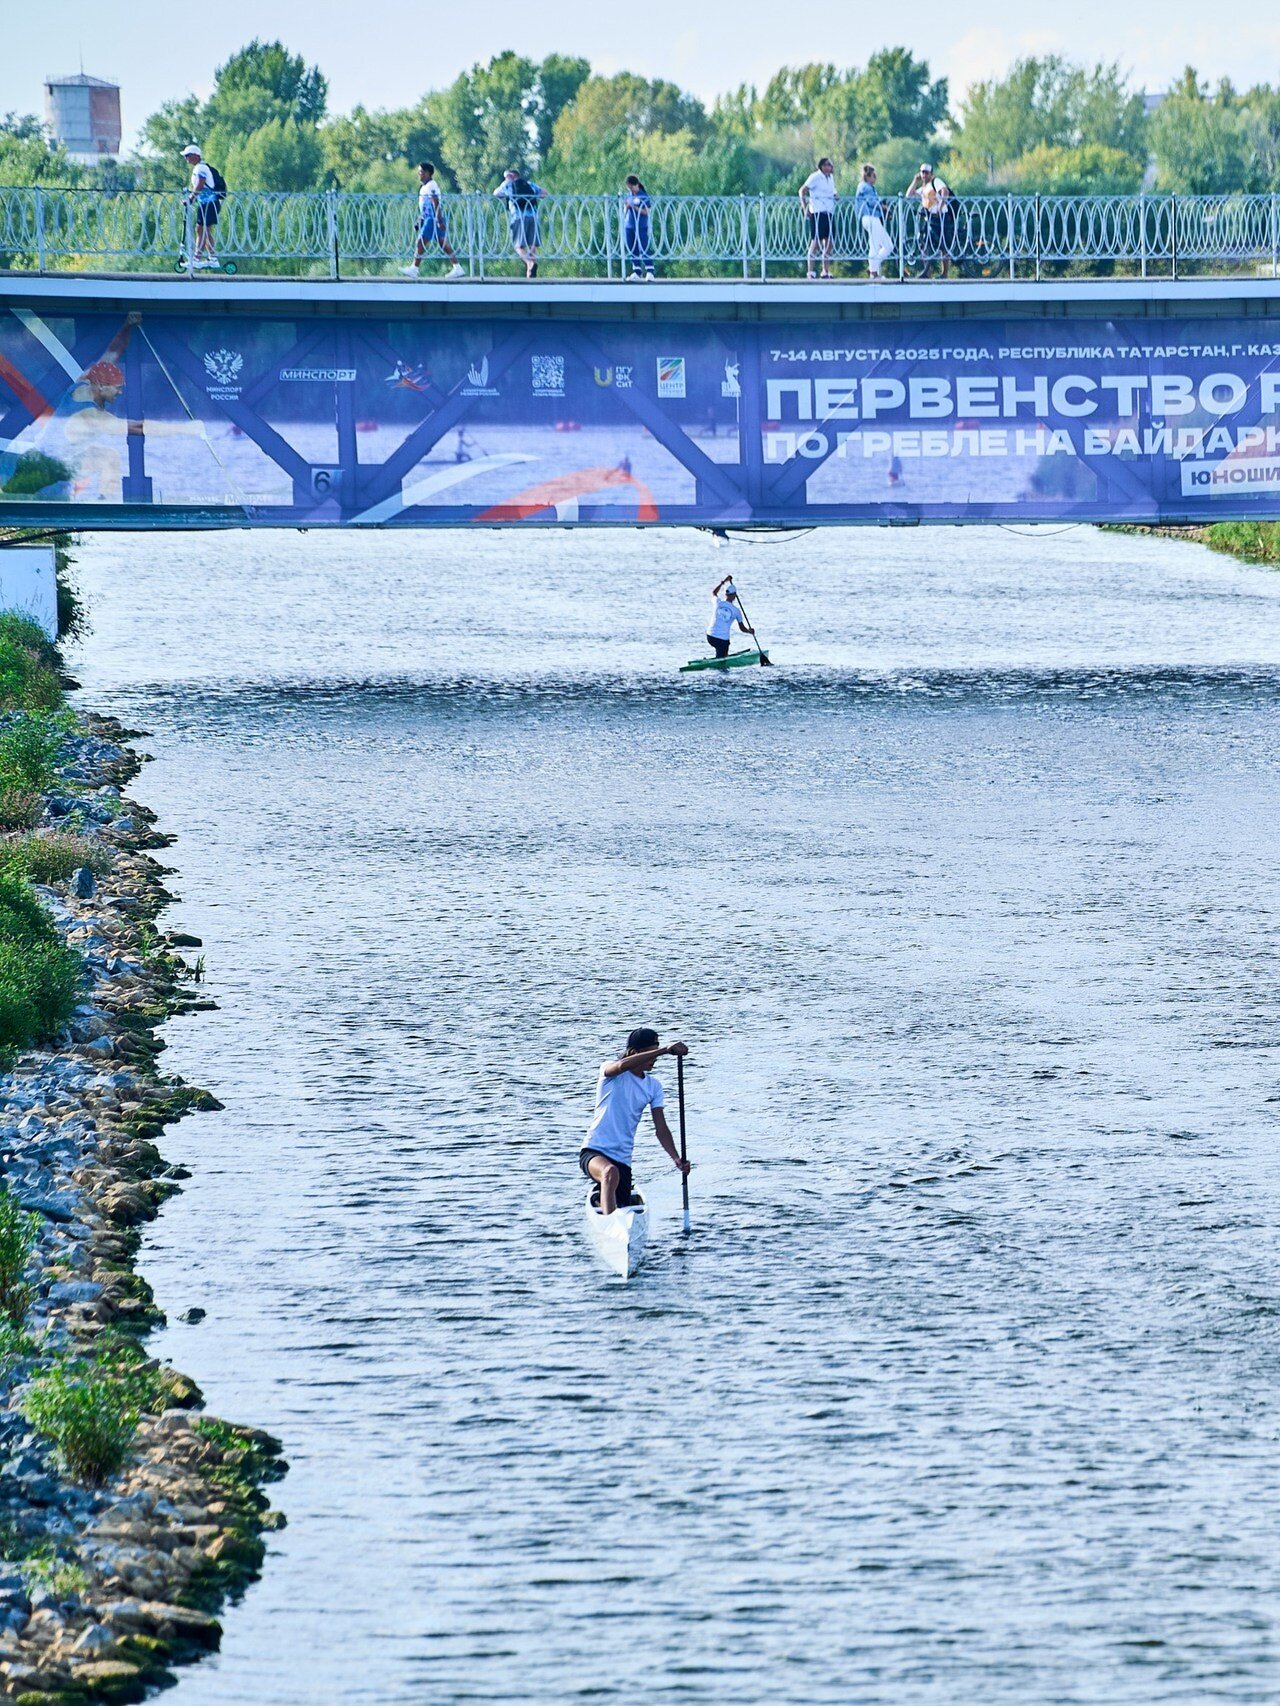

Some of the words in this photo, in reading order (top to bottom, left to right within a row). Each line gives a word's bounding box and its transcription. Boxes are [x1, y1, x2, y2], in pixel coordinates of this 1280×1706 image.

[770, 350, 807, 362] 7-14
[810, 349, 889, 362] АВГУСТА
[895, 349, 940, 360] 2025
[942, 348, 994, 361] ГОДА,
[999, 347, 1115, 360] РЕСПУБЛИКА
[1117, 345, 1230, 358] ТАТАРСТАН,
[281, 370, 356, 380] МИНСПОРТ
[766, 371, 1247, 420] ПЕРВЕНСТВО
[767, 431, 829, 459] ПО
[836, 430, 1007, 458] ГРЕБЛЕ
[1015, 429, 1077, 456] НА
[314, 471, 331, 493] 6
[1191, 467, 1280, 486] ЮНОШИ
